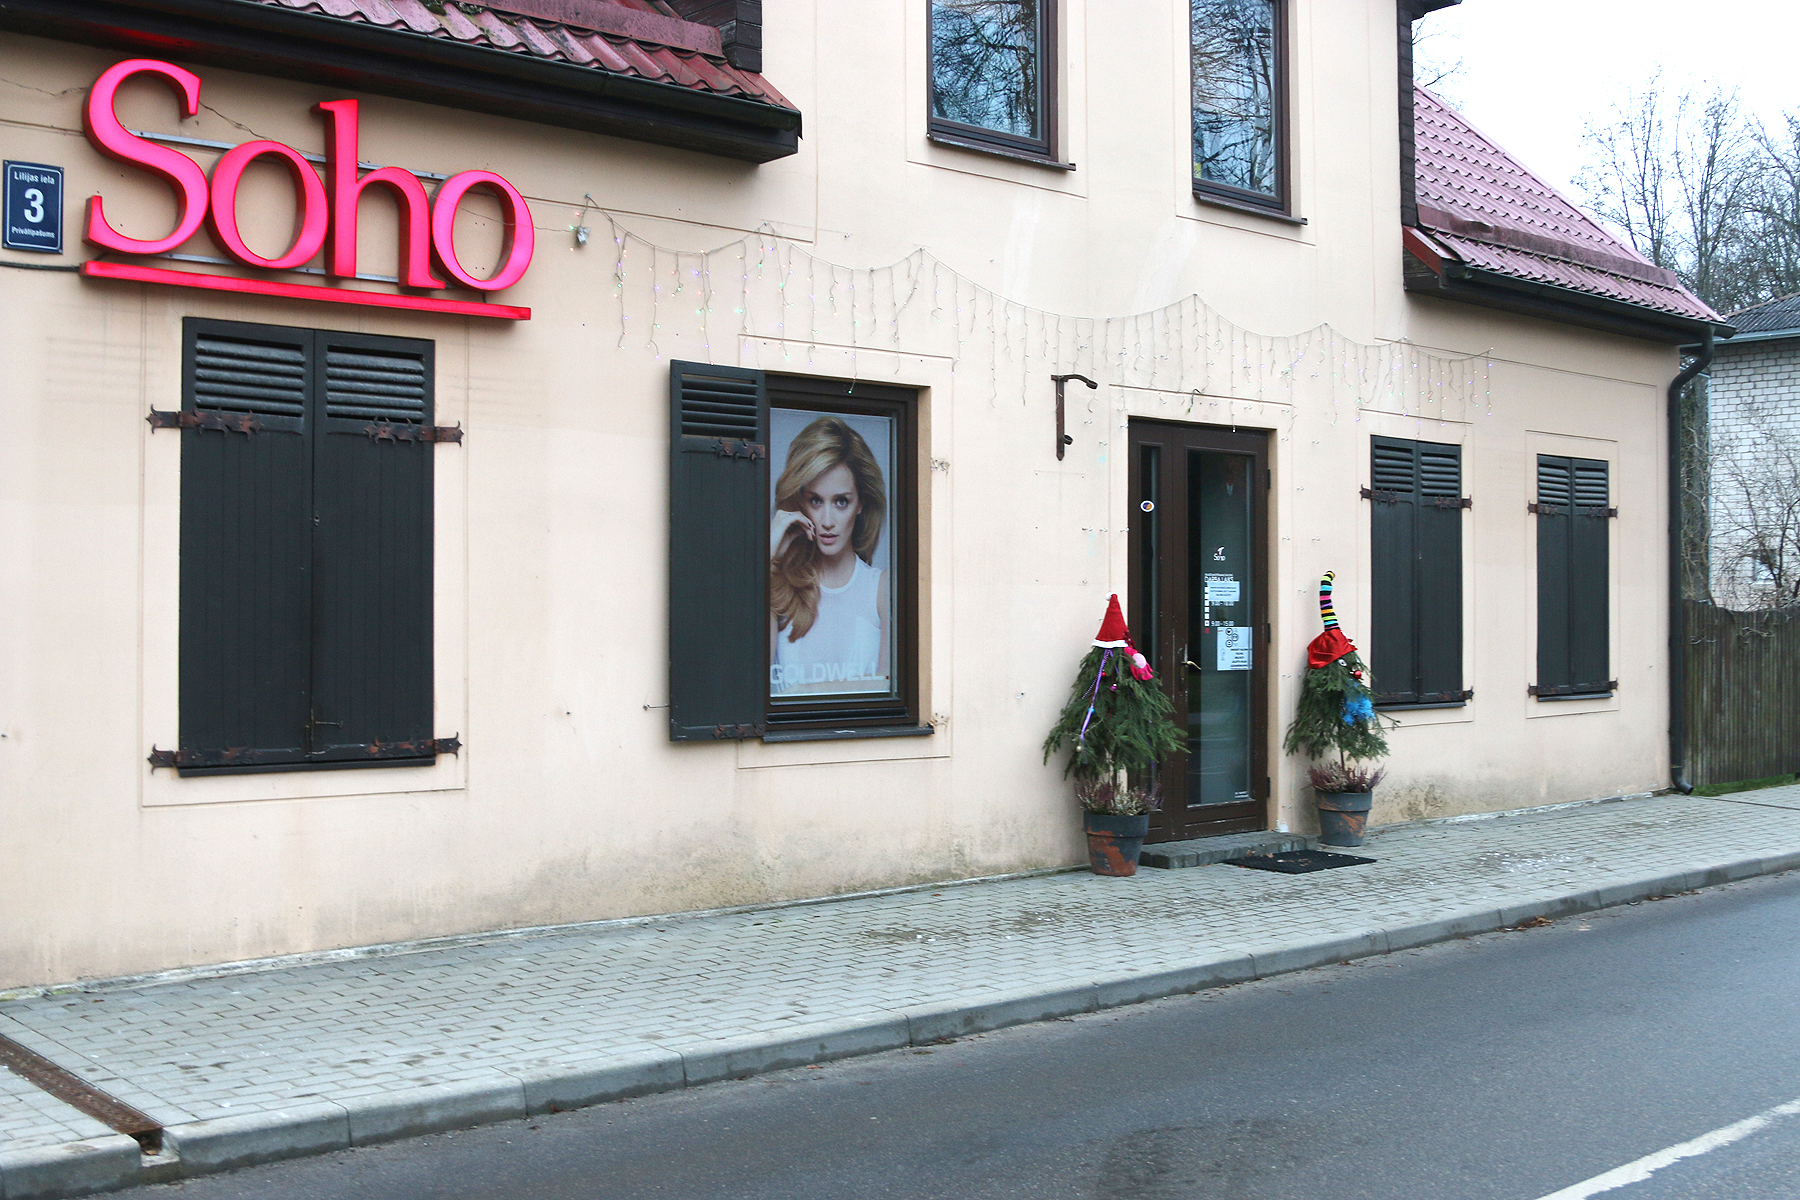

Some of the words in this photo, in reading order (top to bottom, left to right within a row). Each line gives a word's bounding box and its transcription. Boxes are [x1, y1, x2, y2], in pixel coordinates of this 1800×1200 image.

[13, 171, 39, 183] Lilijas
[40, 174, 55, 185] iela
[82, 58, 535, 291] Soho
[24, 187, 45, 224] 3
